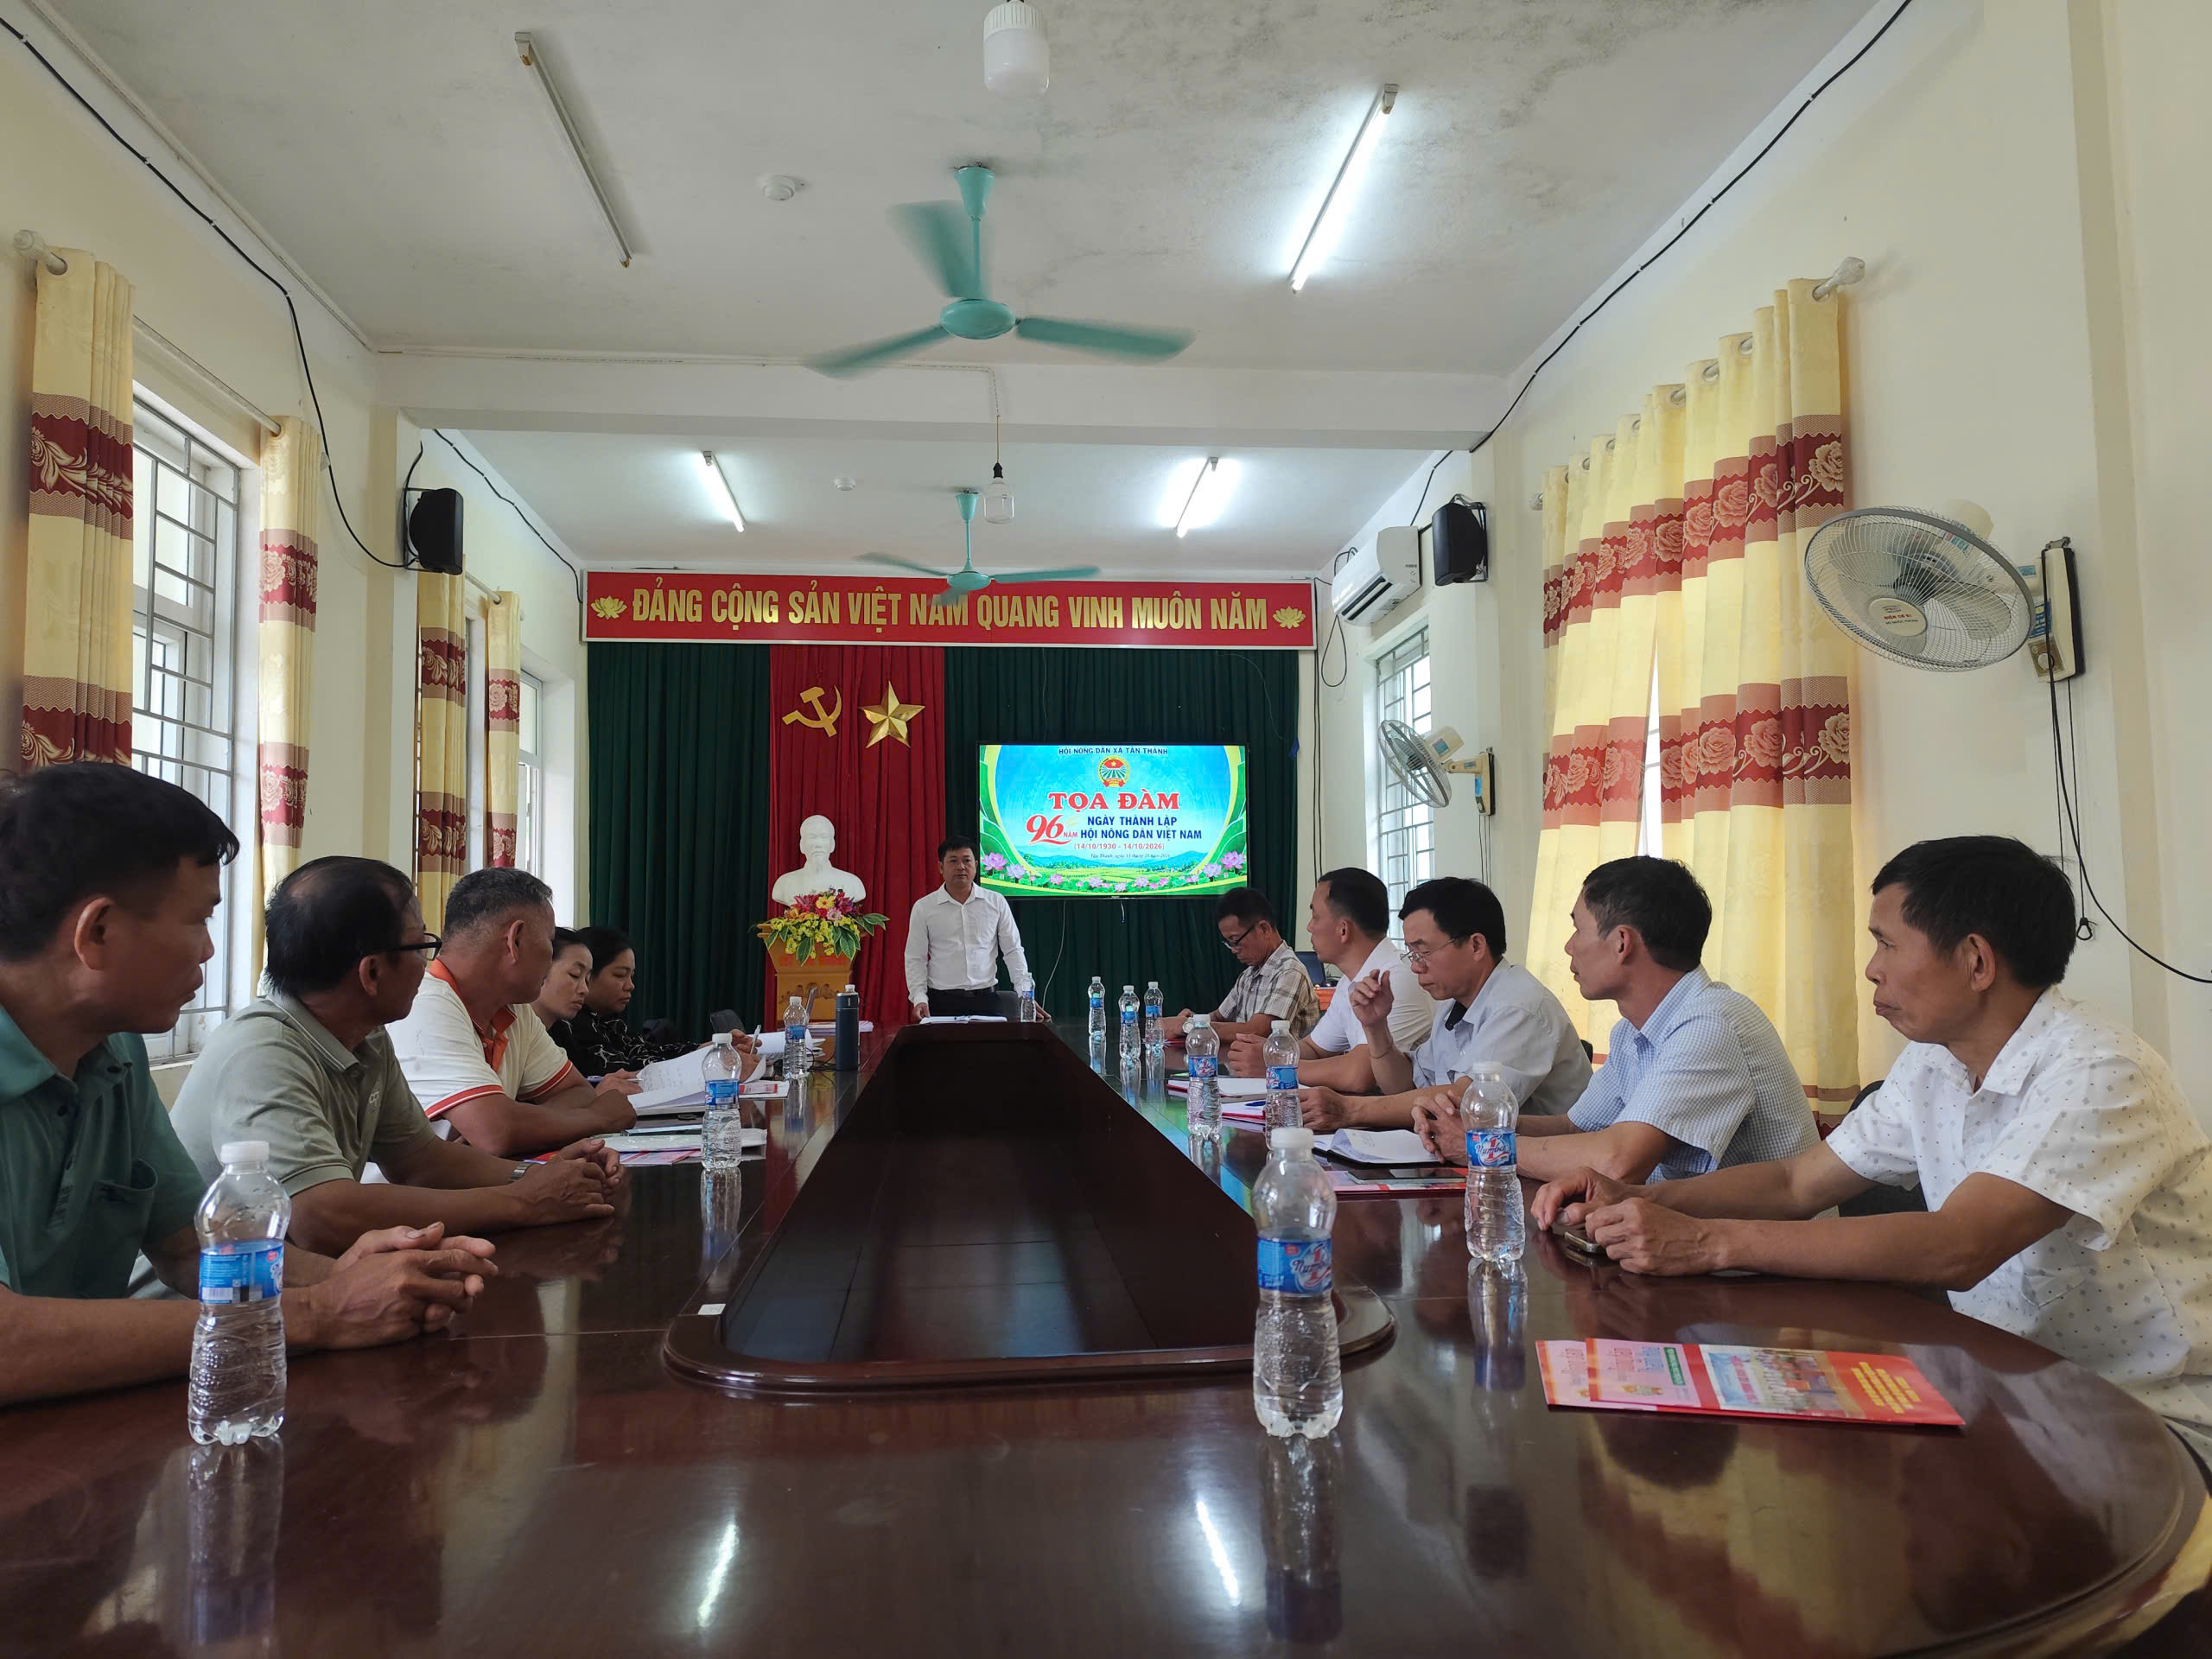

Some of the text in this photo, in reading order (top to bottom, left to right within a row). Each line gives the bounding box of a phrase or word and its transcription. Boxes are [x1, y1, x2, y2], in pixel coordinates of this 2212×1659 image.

[632, 577, 1268, 633] ĐẢNG CỘNG SẢN VIỆT NAM QUANG VINH MUÔN NĂM
[1073, 746, 1094, 754] NÔNG
[1126, 746, 1141, 754] TÂN
[1142, 747, 1168, 755] THÀNH
[1047, 788, 1180, 813] TỌA ĐÀM
[1026, 814, 1066, 844] 96
[1087, 814, 1178, 828] NGÀY THÀNH LẬP
[1080, 827, 1202, 842] HỘI NÔNG DÂN VIỆT NAM
